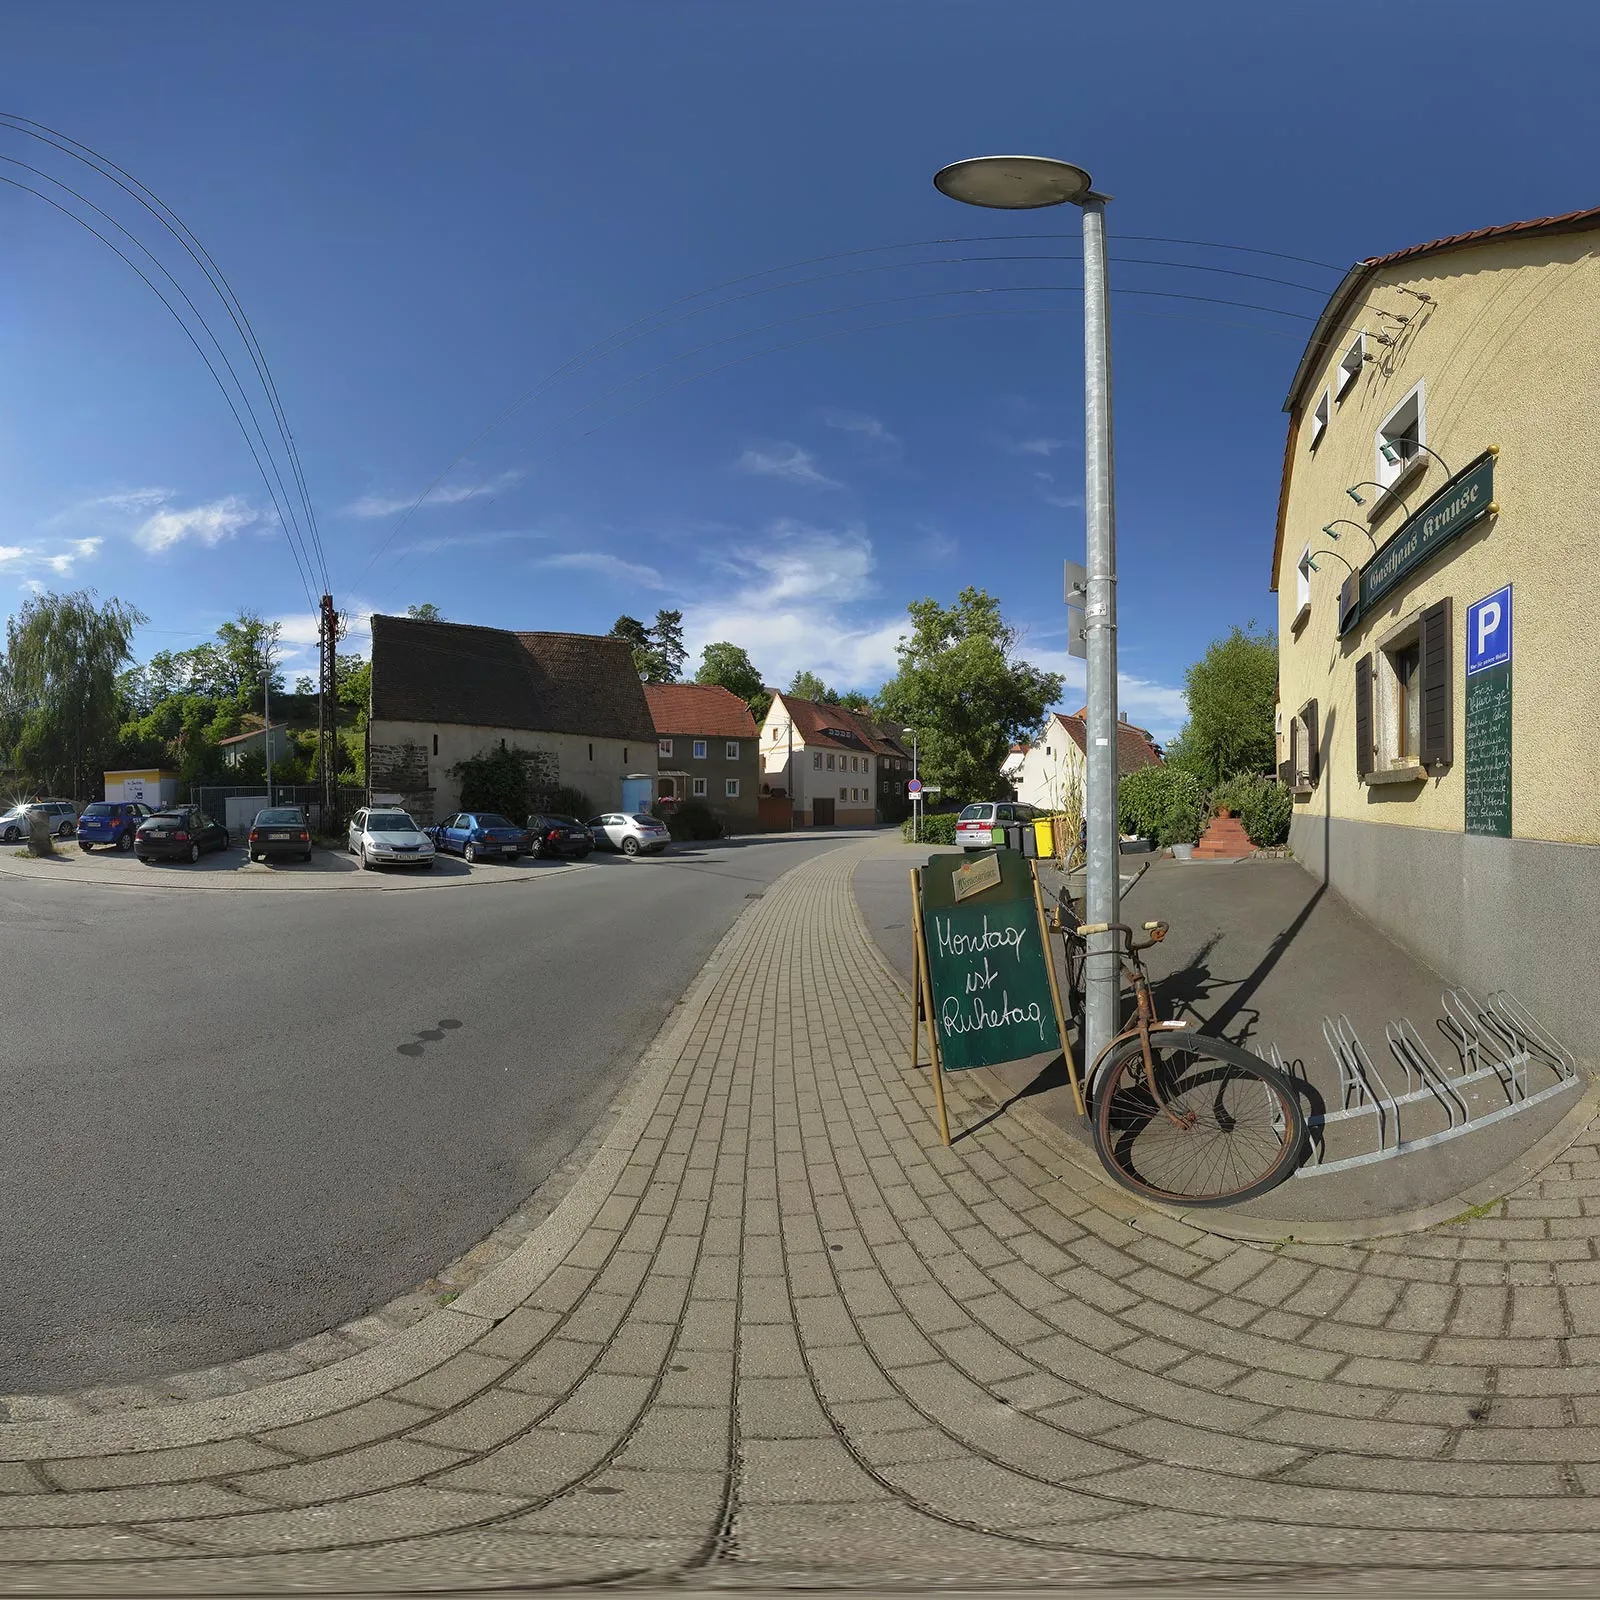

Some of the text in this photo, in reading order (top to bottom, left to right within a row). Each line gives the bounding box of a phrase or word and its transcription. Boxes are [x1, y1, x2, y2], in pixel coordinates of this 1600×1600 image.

[1370, 484, 1480, 590] Gasthaus Krause
[1478, 601, 1501, 655] P
[935, 914, 1026, 963] Montag
[965, 956, 999, 994] ist
[941, 989, 1047, 1041] Ruhetag
